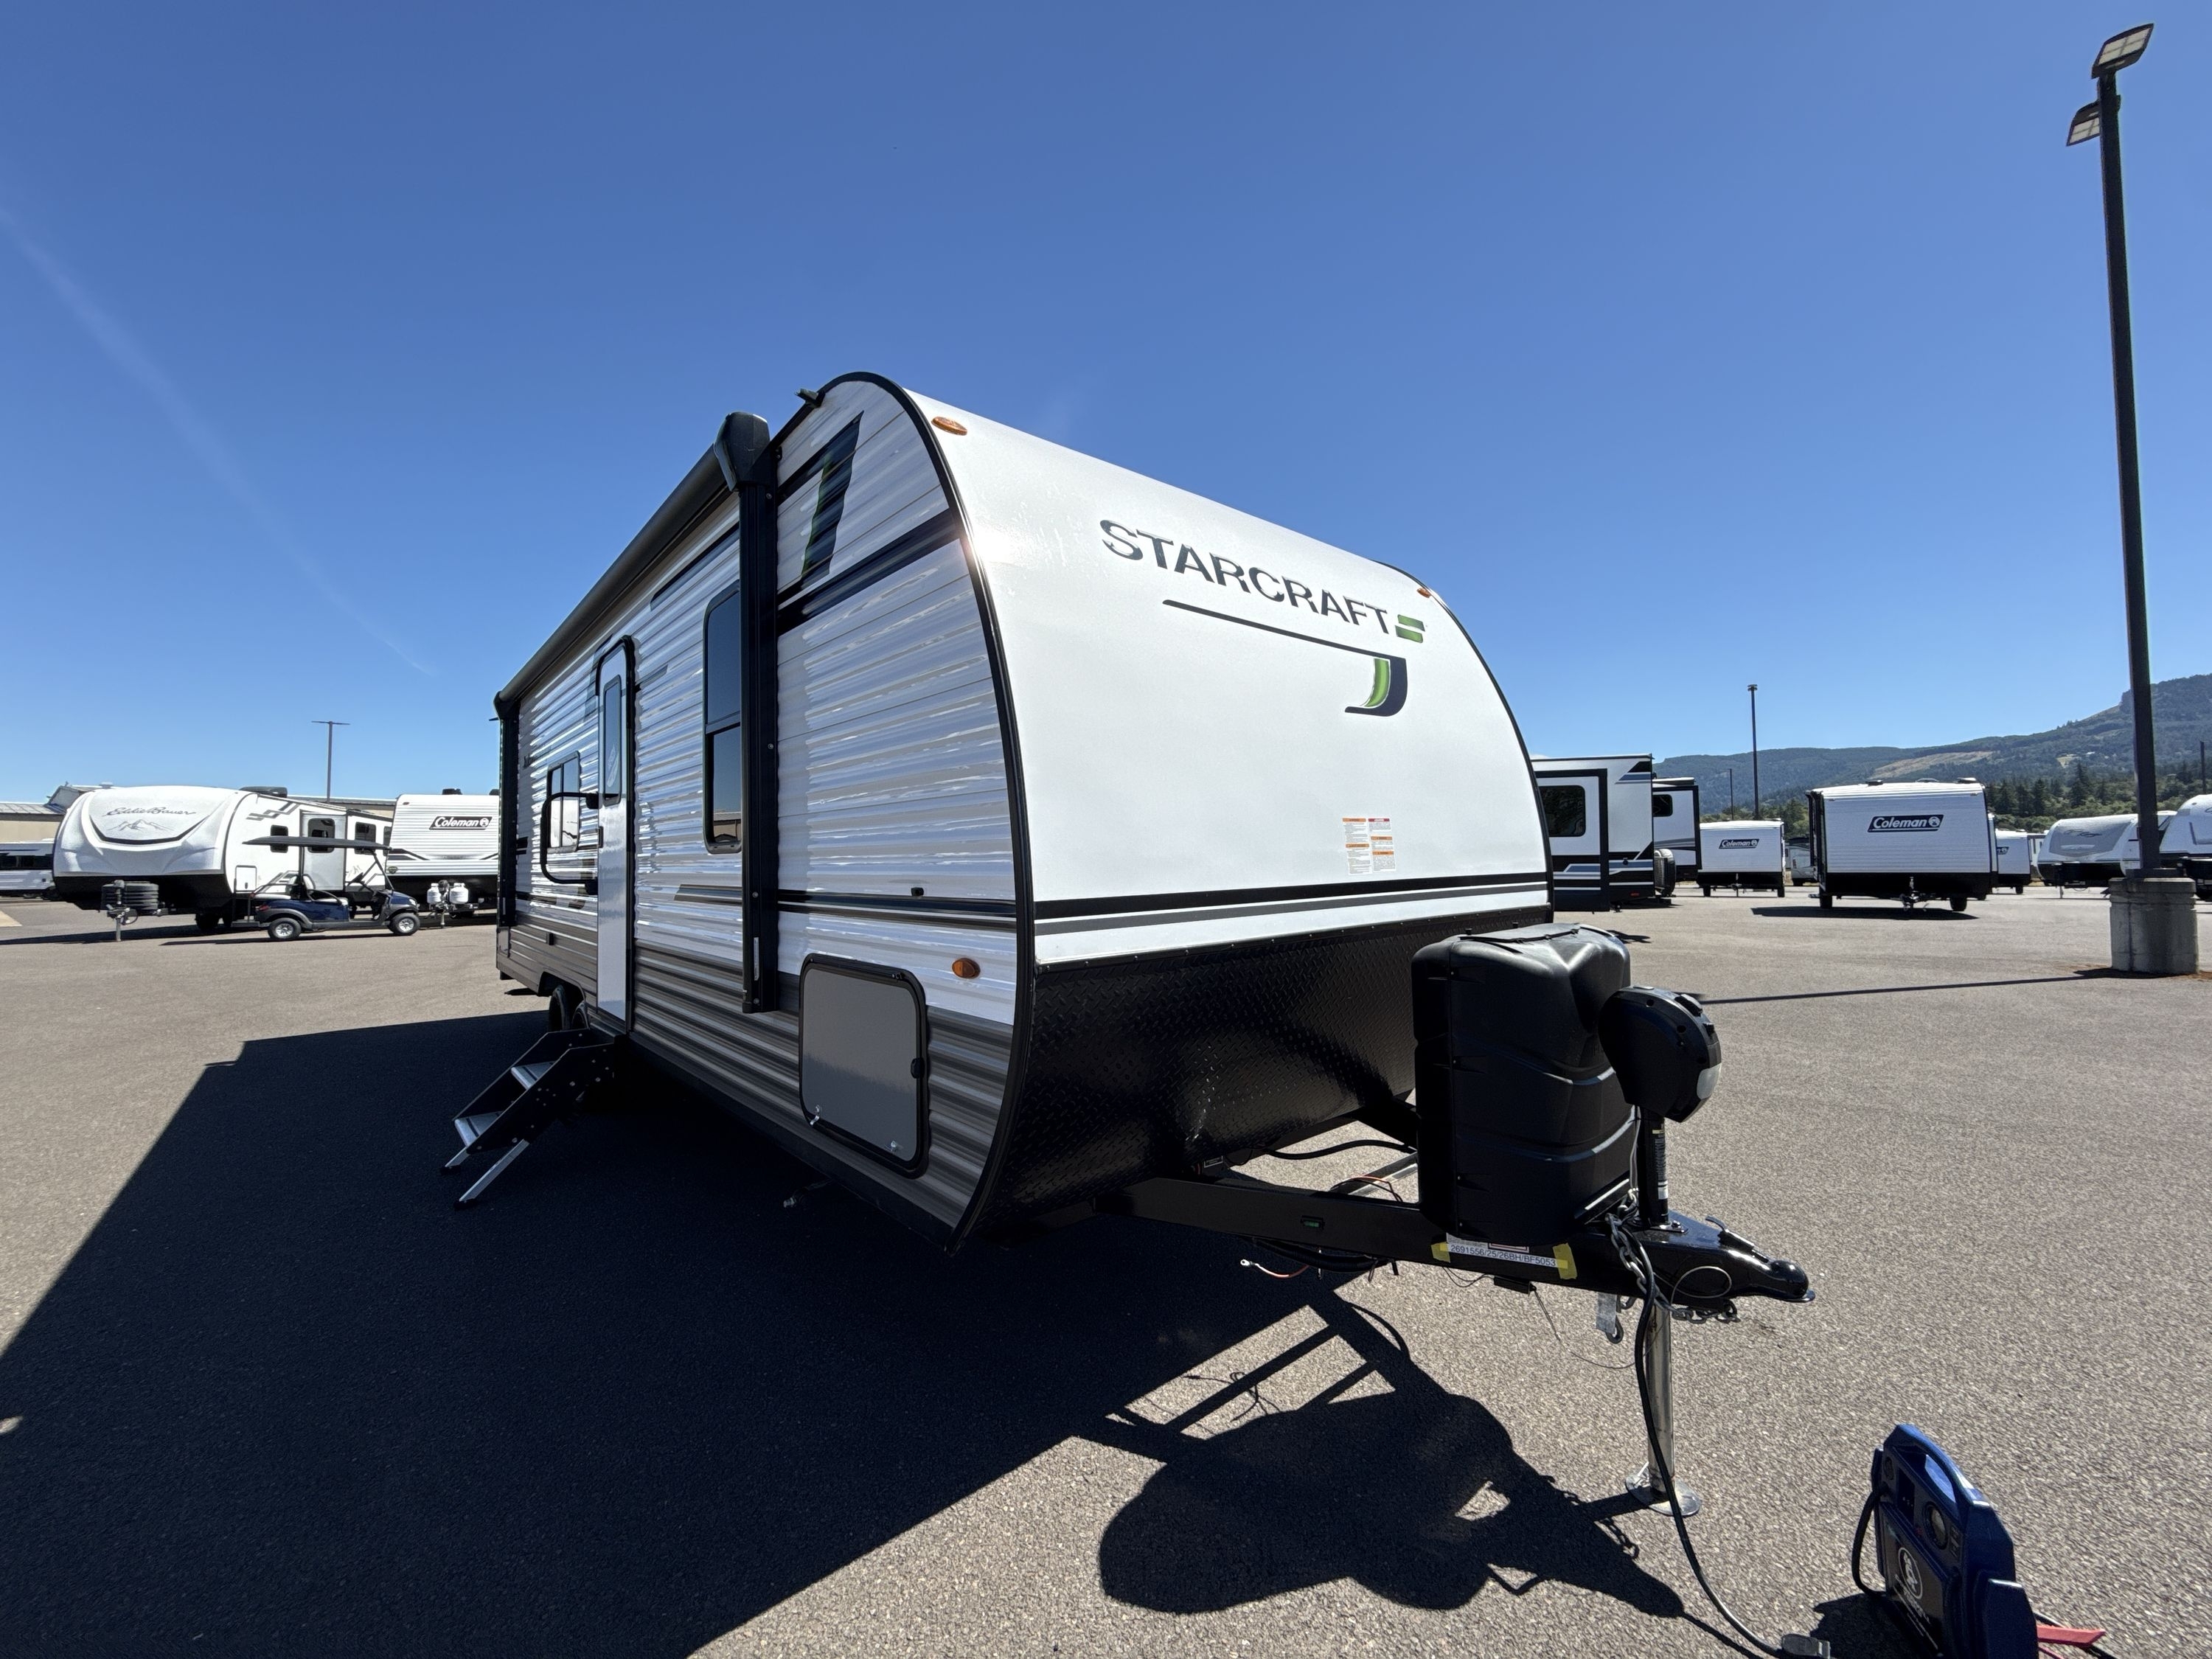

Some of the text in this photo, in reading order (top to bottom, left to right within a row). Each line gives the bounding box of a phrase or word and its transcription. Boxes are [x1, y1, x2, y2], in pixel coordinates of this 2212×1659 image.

[1099, 519, 1389, 634] STARCRAFT
[434, 816, 479, 827] Coleman
[1873, 817, 1927, 829] Coleman
[1722, 839, 1750, 847] Coleman
[1451, 1244, 1556, 1266] 2691556/25/26BH/BF5053
